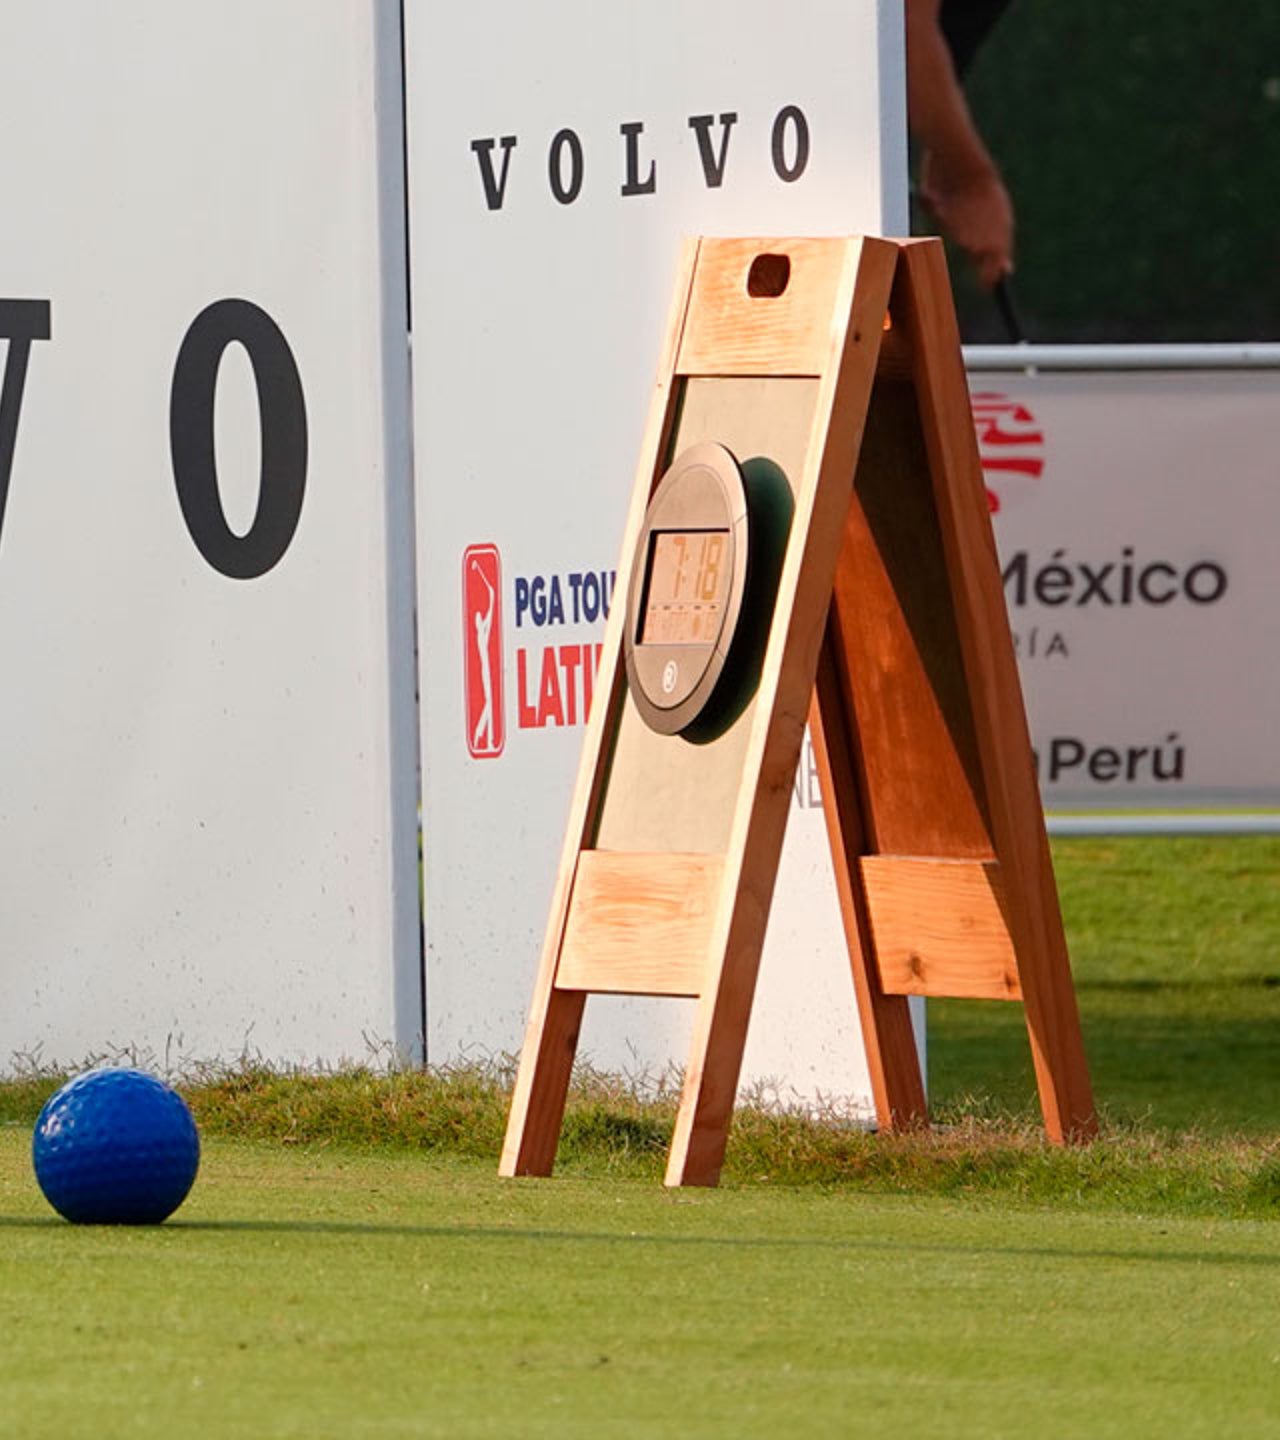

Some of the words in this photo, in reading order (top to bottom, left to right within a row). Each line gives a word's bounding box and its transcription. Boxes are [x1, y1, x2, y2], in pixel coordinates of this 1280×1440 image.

[470, 105, 810, 210] VOLVO
[515, 575, 566, 627] PGA
[568, 570, 617, 624] TOU
